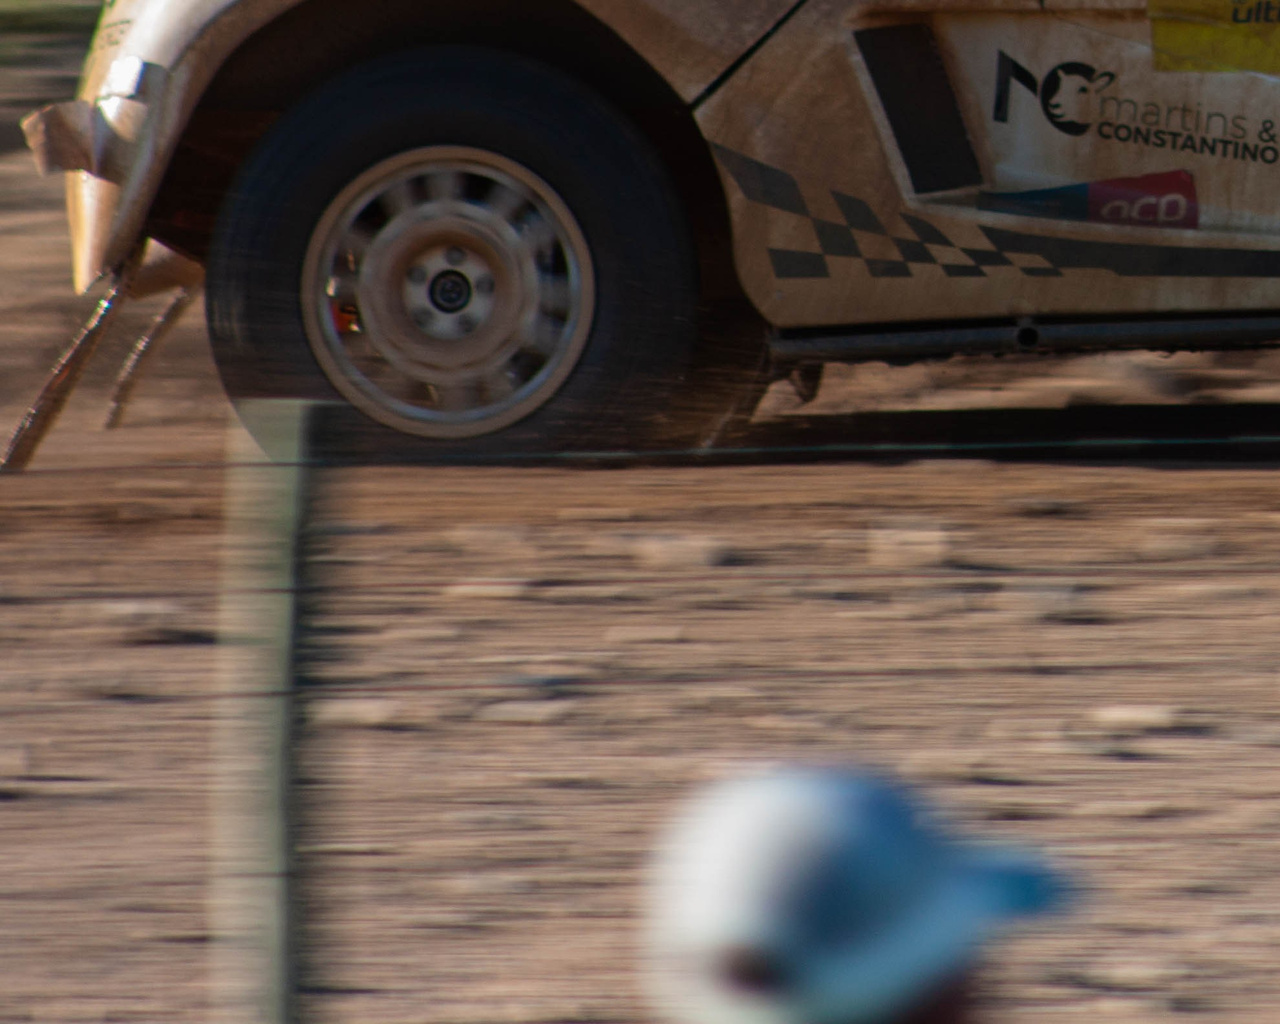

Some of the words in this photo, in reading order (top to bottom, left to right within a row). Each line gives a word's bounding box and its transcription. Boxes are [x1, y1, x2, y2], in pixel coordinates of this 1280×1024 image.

[1096, 121, 1280, 165] CONSTANTINO
[1099, 95, 1248, 140] martins
[1257, 118, 1279, 145] &
